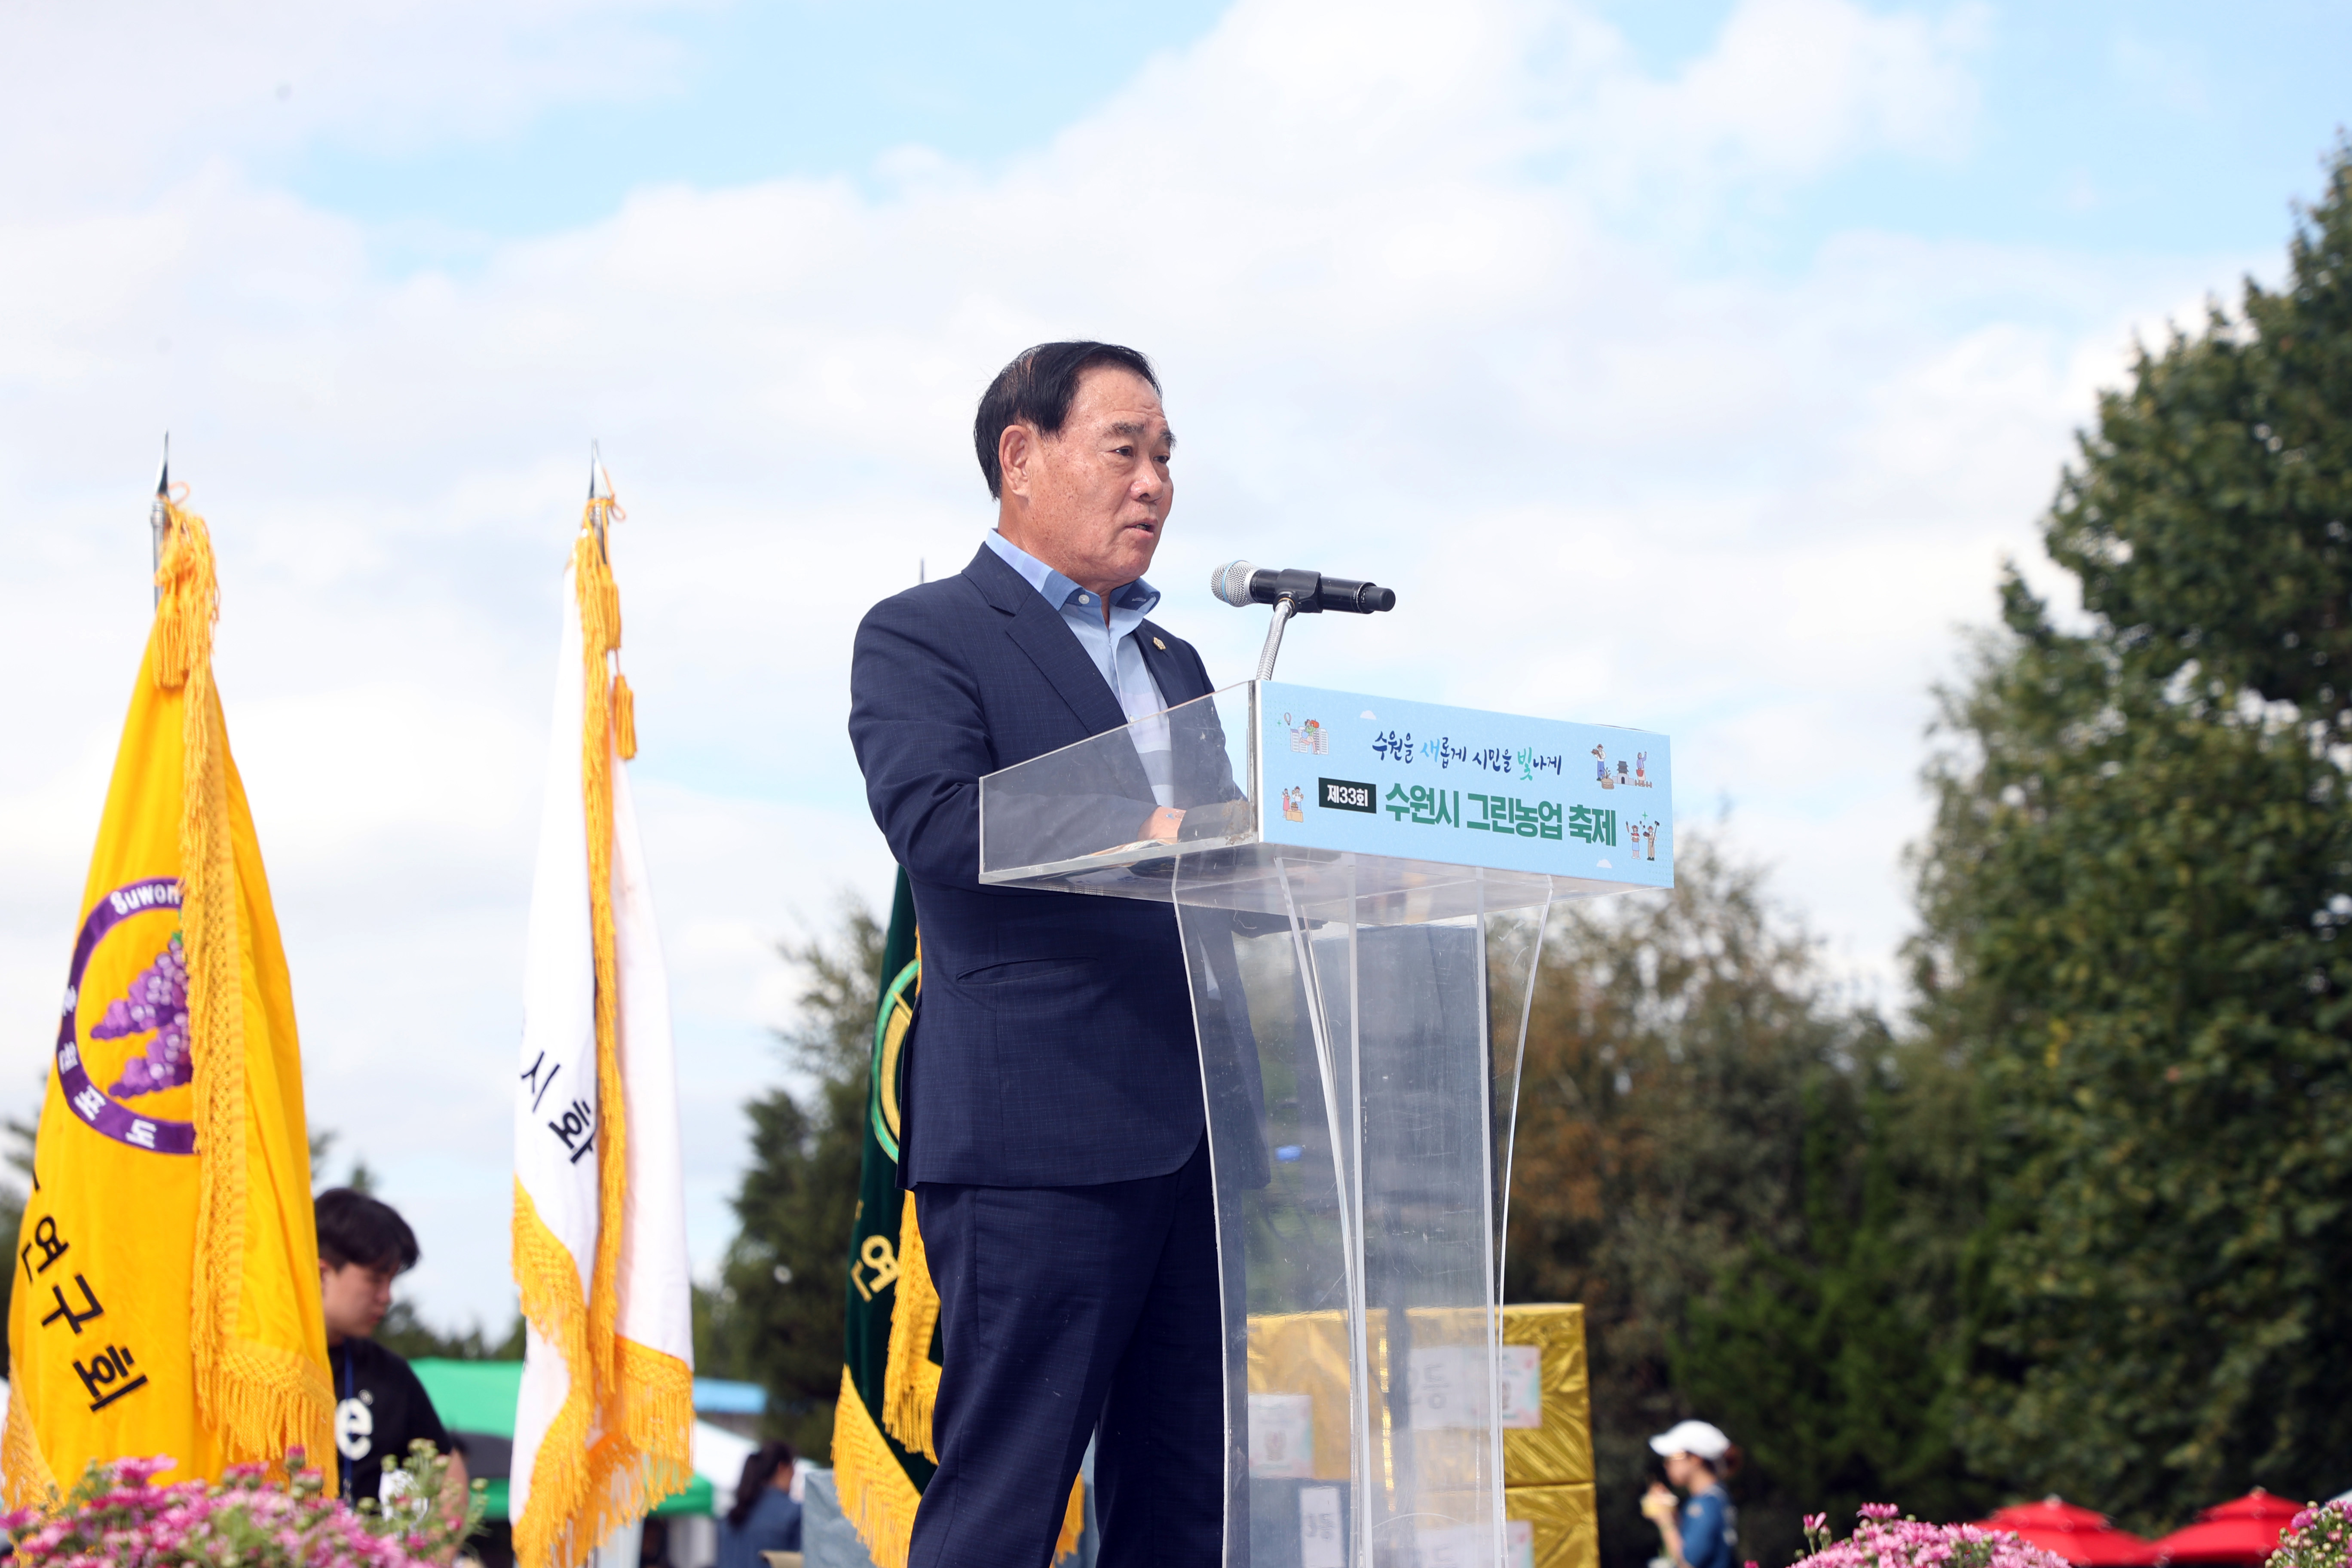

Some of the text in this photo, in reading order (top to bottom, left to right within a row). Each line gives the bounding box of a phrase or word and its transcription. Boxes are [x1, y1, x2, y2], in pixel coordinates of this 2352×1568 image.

[1372, 730, 1562, 781] 수원을 새롭게 시민을 빛나게
[1327, 782, 1617, 847] 제33회 수원시 그린농업 축제
[21, 1168, 148, 1412] 연구회
